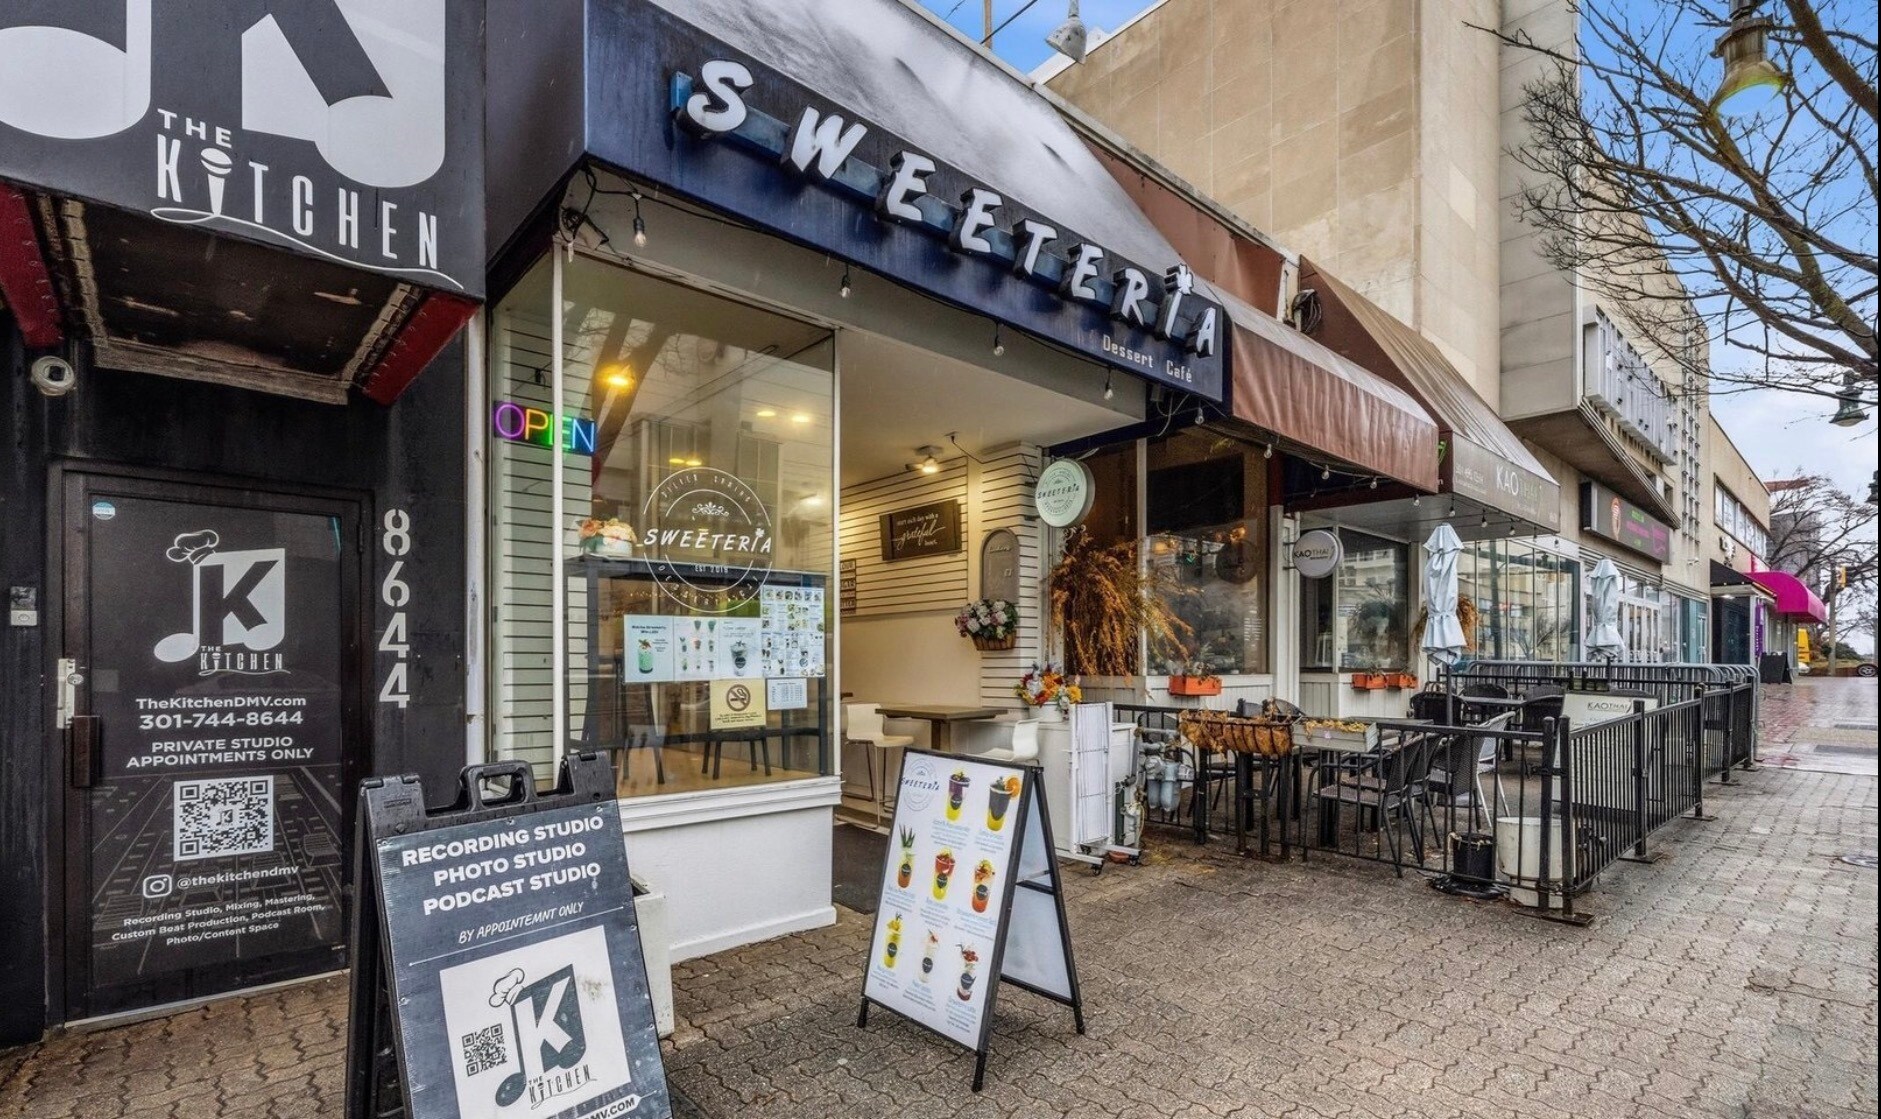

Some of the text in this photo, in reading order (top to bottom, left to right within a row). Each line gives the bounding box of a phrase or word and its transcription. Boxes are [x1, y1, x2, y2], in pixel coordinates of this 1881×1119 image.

[157, 107, 232, 148] THE
[156, 133, 438, 270] KITCHEN
[687, 60, 1216, 357] SWEETERIA
[1103, 334, 1192, 382] Dessert Café
[495, 404, 595, 452] OPEN
[644, 528, 772, 553] SWEETERIA
[378, 508, 411, 709] 8644
[200, 653, 283, 670] KITCHEN
[136, 696, 307, 710] TheKitchenDMV.com
[139, 711, 303, 730] 301-744-8644
[126, 748, 314, 768] APPOINTMENTS ONLY
[152, 737, 293, 753] PRIVATE STUDIO
[402, 816, 604, 867] RECORDING STUDIO
[177, 865, 300, 890] @thekitchendmv
[434, 842, 586, 886] PHOTO STUDIO
[423, 862, 601, 916] PODCAST STUDIO
[111, 904, 325, 941] Custom Beat Production, Podcast Room,
[123, 892, 315, 927] Recording Studio, Mixing, Mastering,
[458, 901, 584, 944] BY APPOINTEMNT ONLY
[166, 922, 279, 946] Photo/Content Space
